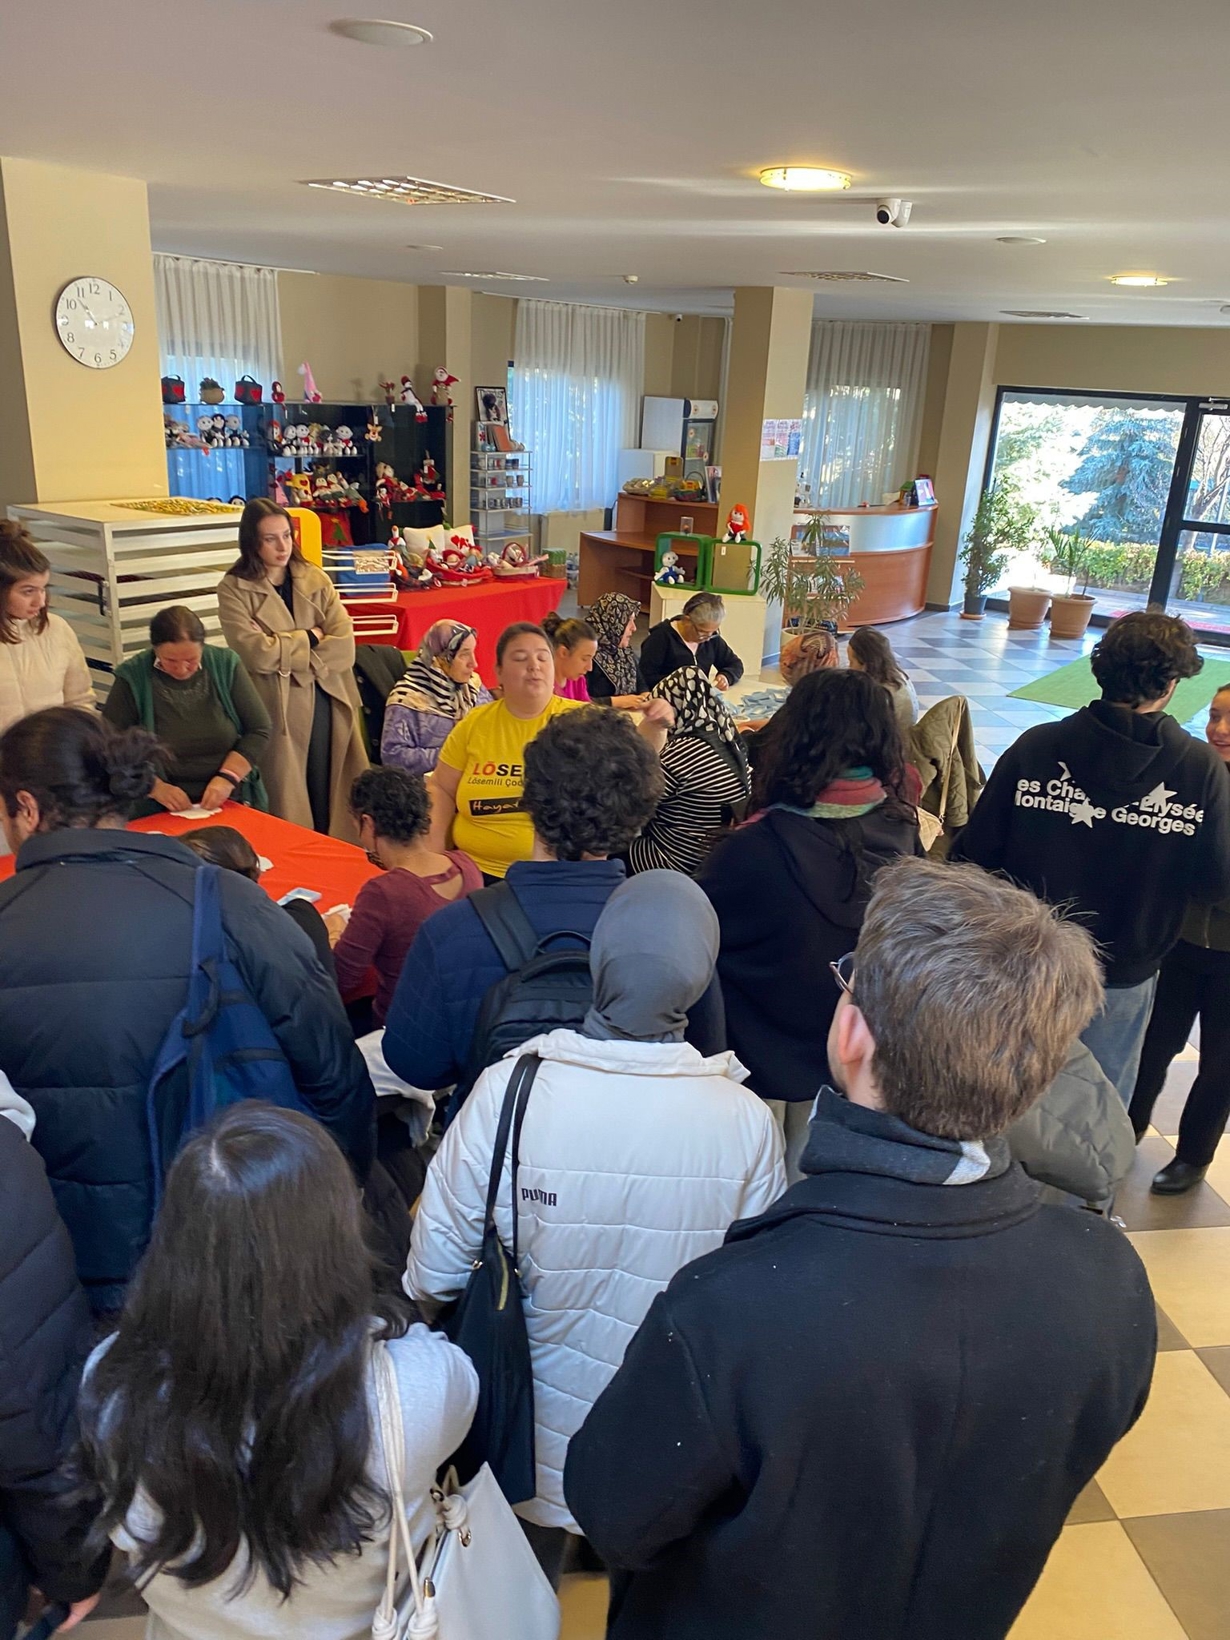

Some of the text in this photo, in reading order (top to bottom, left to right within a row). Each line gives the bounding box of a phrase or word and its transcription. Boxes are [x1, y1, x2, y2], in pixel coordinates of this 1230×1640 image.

[77, 286, 85, 298] 11
[89, 283, 100, 295] 12
[109, 290, 112, 301] 1
[66, 298, 77, 310] 10
[66, 332, 75, 343] 8
[78, 347, 85, 358] 7
[94, 353, 102, 363] 6
[109, 349, 117, 361] 5
[473, 761, 522, 777] LÖSE
[467, 777, 502, 786] Lösemili
[1046, 779, 1087, 801] Cha
[1111, 807, 1196, 836] Georges
[521, 1187, 557, 1207] PUMA
